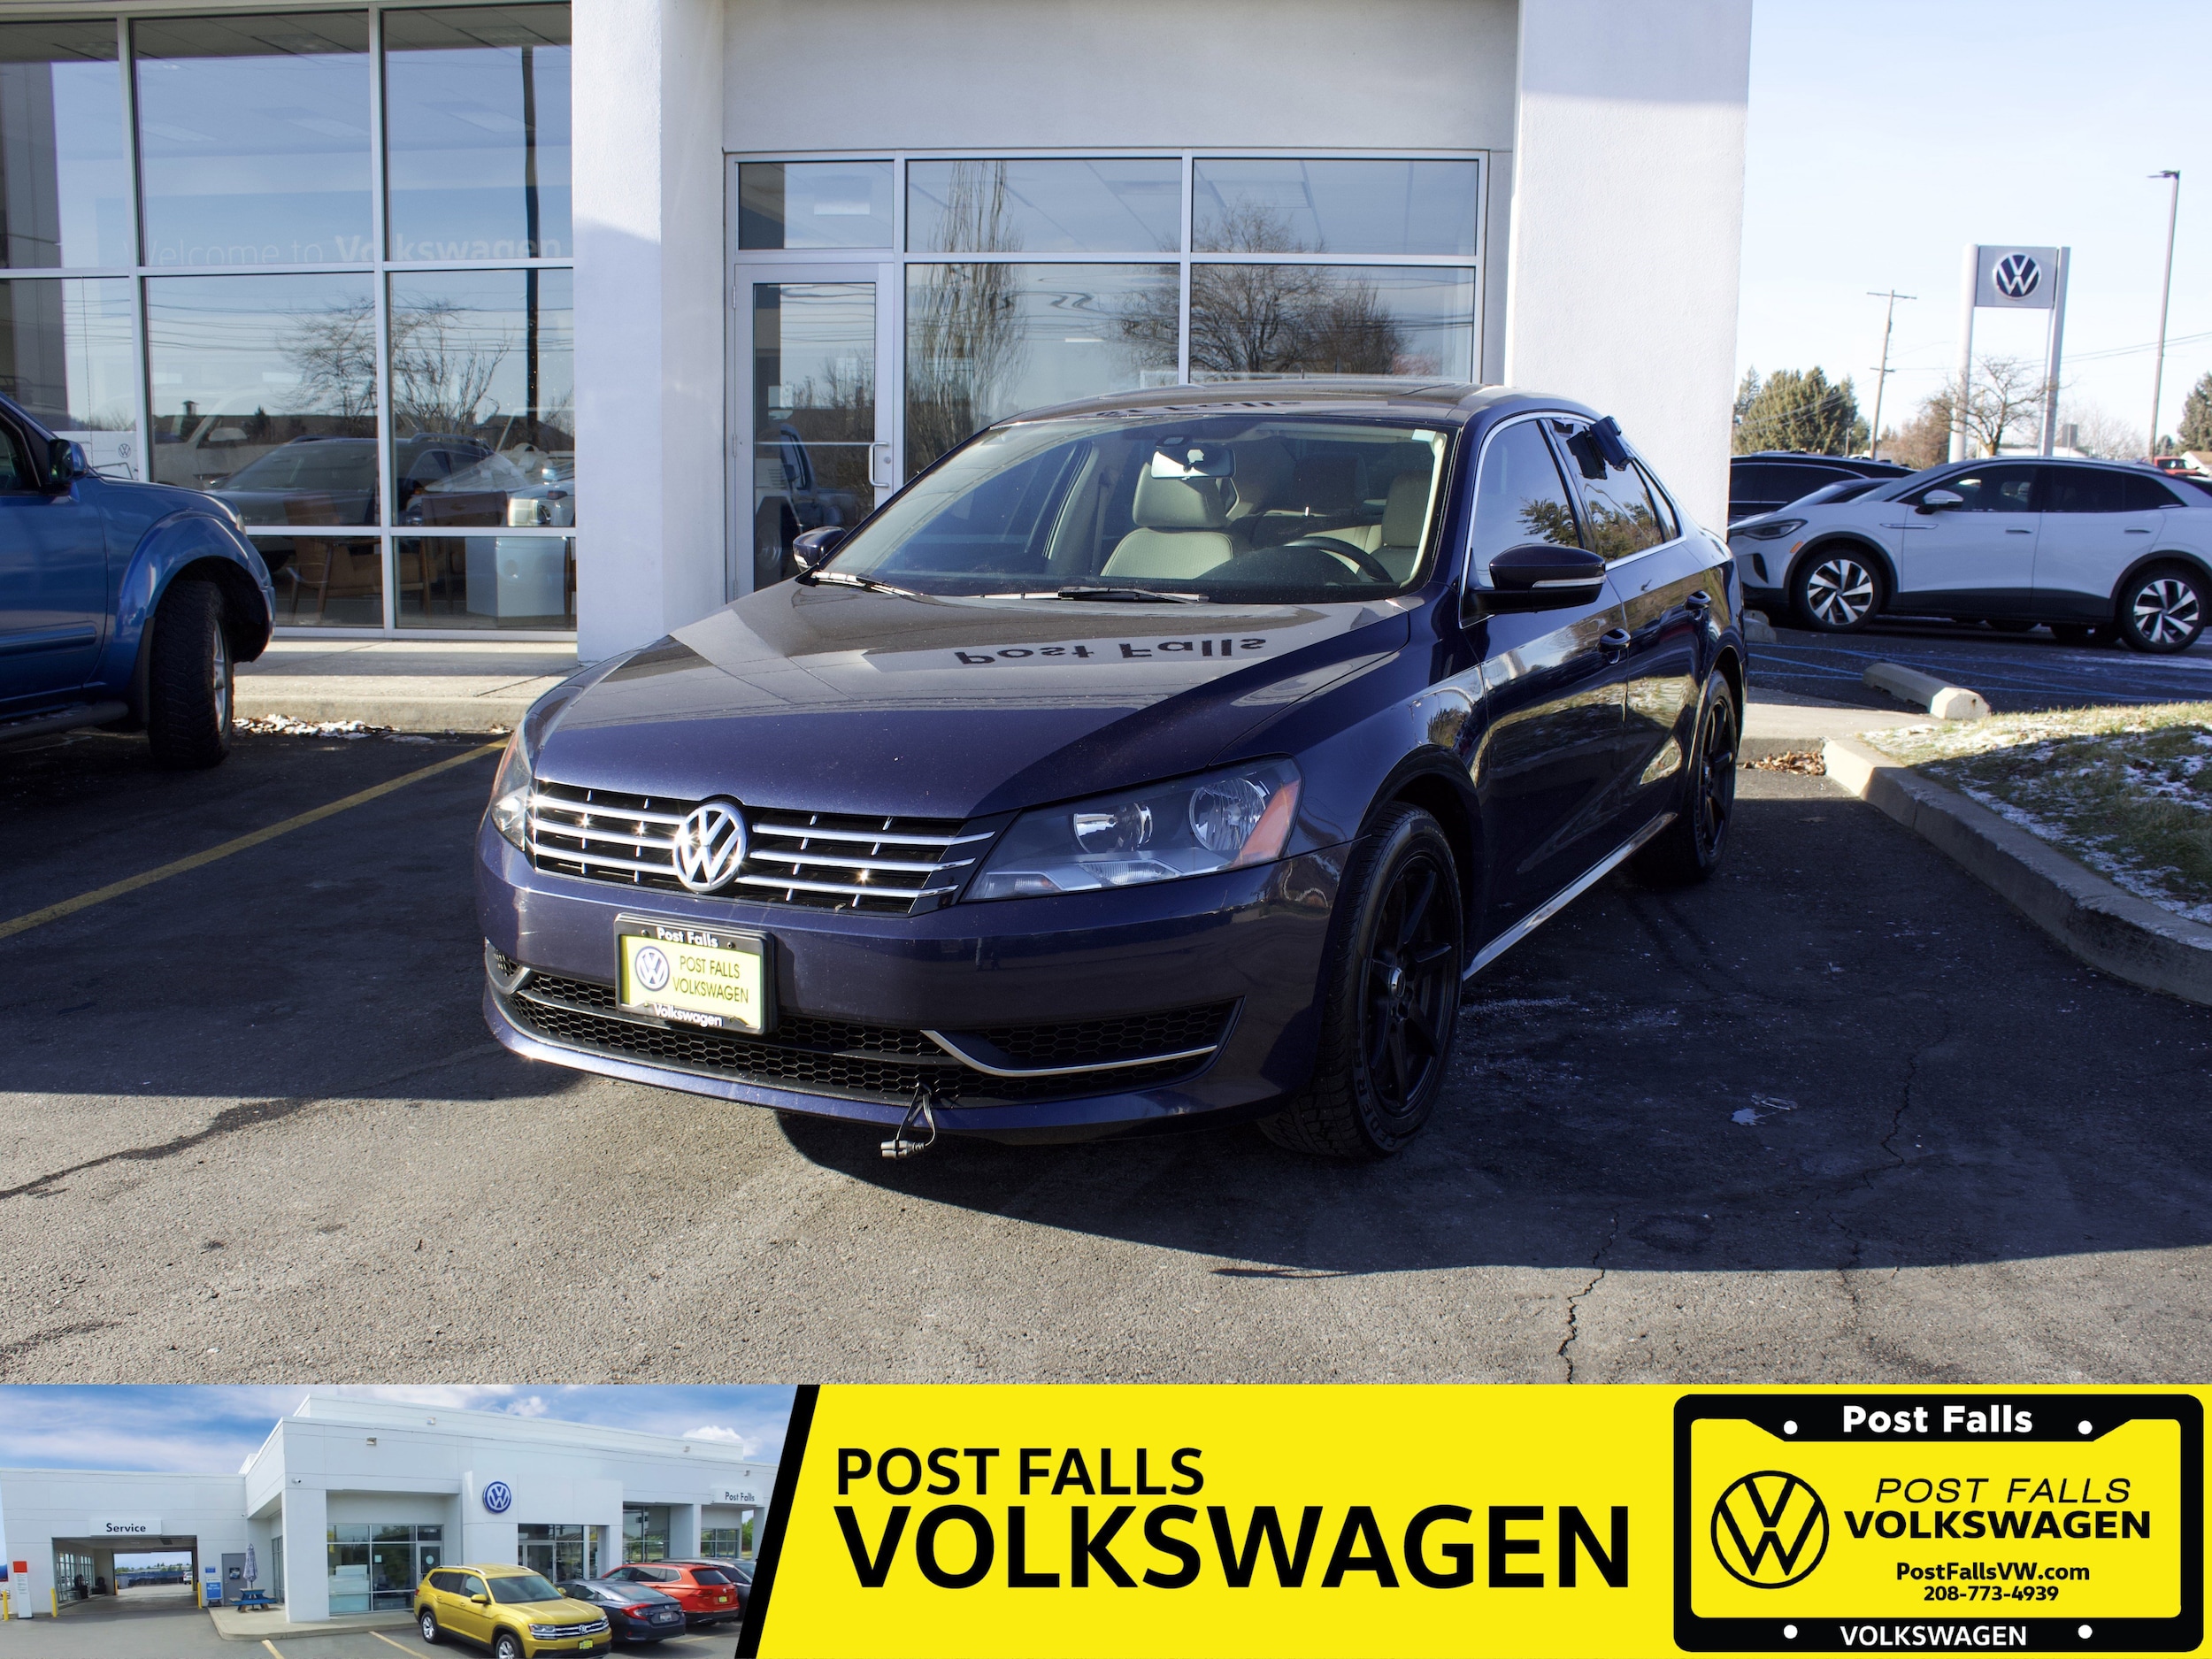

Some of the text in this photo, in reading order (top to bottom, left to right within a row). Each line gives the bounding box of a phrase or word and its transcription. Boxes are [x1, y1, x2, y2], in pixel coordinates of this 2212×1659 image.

[291, 240, 323, 263] to
[335, 233, 562, 262] Vokswagen
[1993, 252, 2041, 301] VW
[673, 803, 747, 892] VW
[657, 926, 718, 949] Post Falls
[680, 956, 740, 979] POST FALLS
[672, 977, 749, 1003] VOLKSWAGEN
[654, 1002, 723, 1027] Volkswagen
